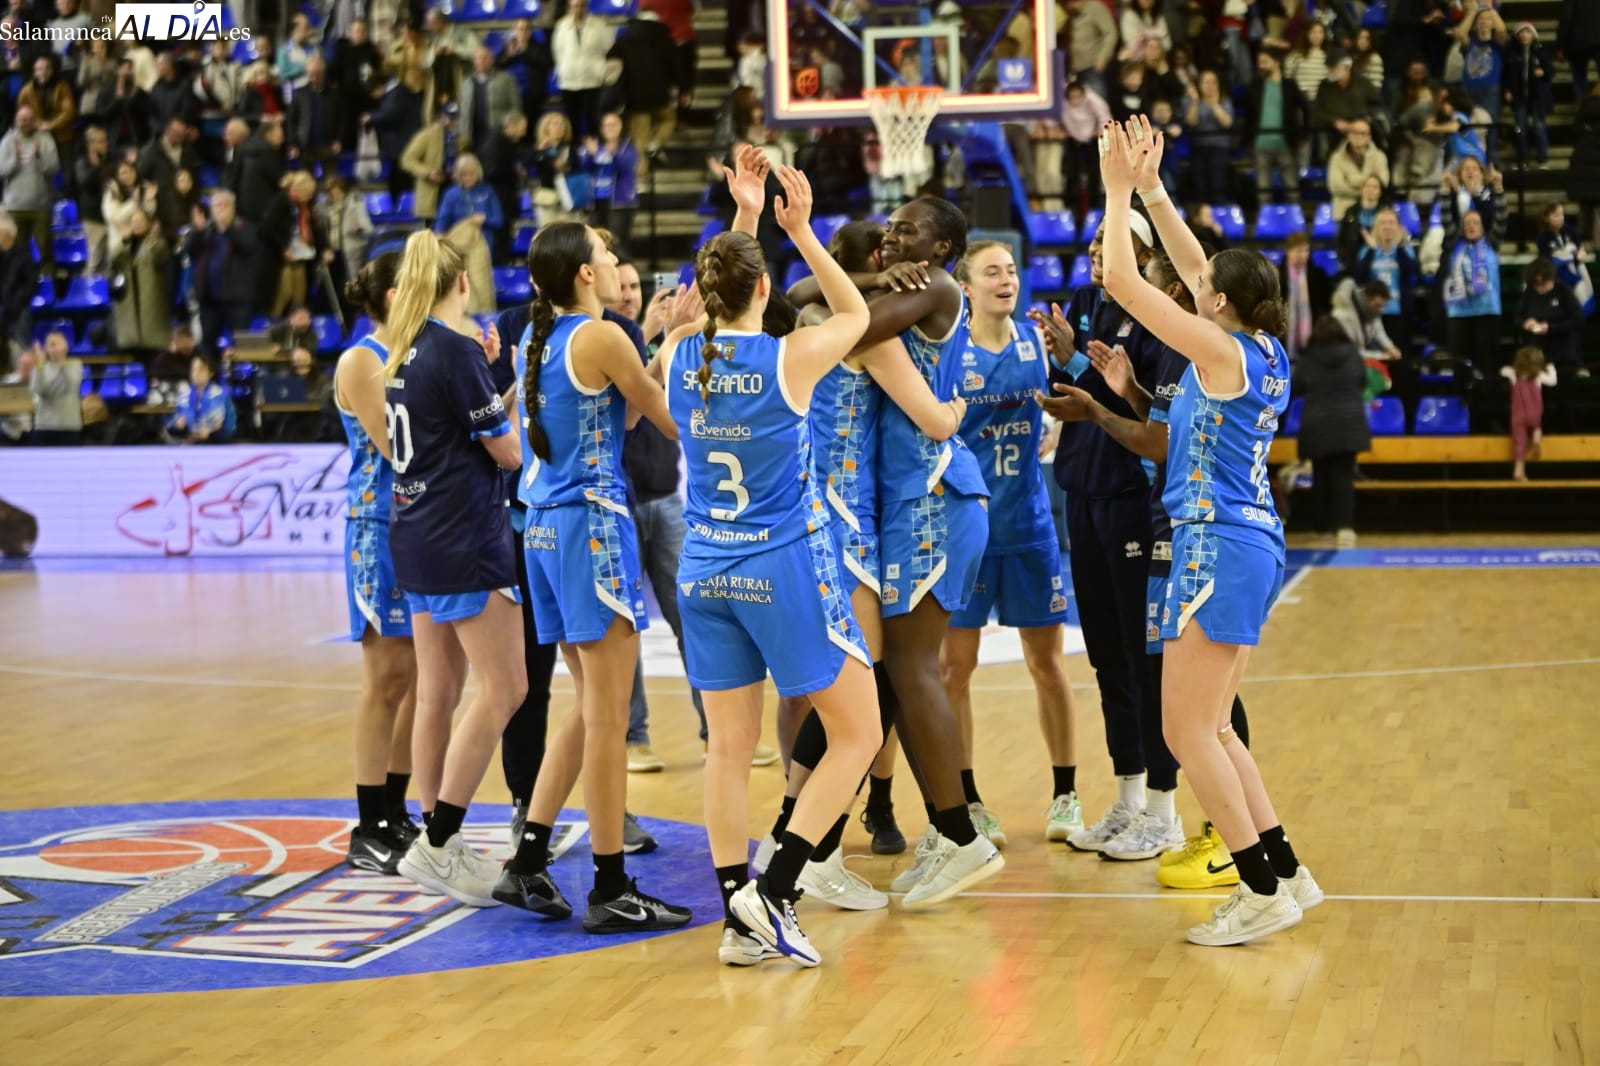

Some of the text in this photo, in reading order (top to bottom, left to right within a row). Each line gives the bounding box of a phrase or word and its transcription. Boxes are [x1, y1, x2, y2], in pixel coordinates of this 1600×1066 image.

[683, 370, 762, 394] SPEAFICO
[964, 394, 1011, 405] CASTILLA
[1014, 390, 1021, 401] Y
[993, 443, 1020, 476] 12
[707, 451, 750, 522] 3
[731, 576, 773, 592] RURAL
[699, 588, 773, 604] DE SALAMANCA
